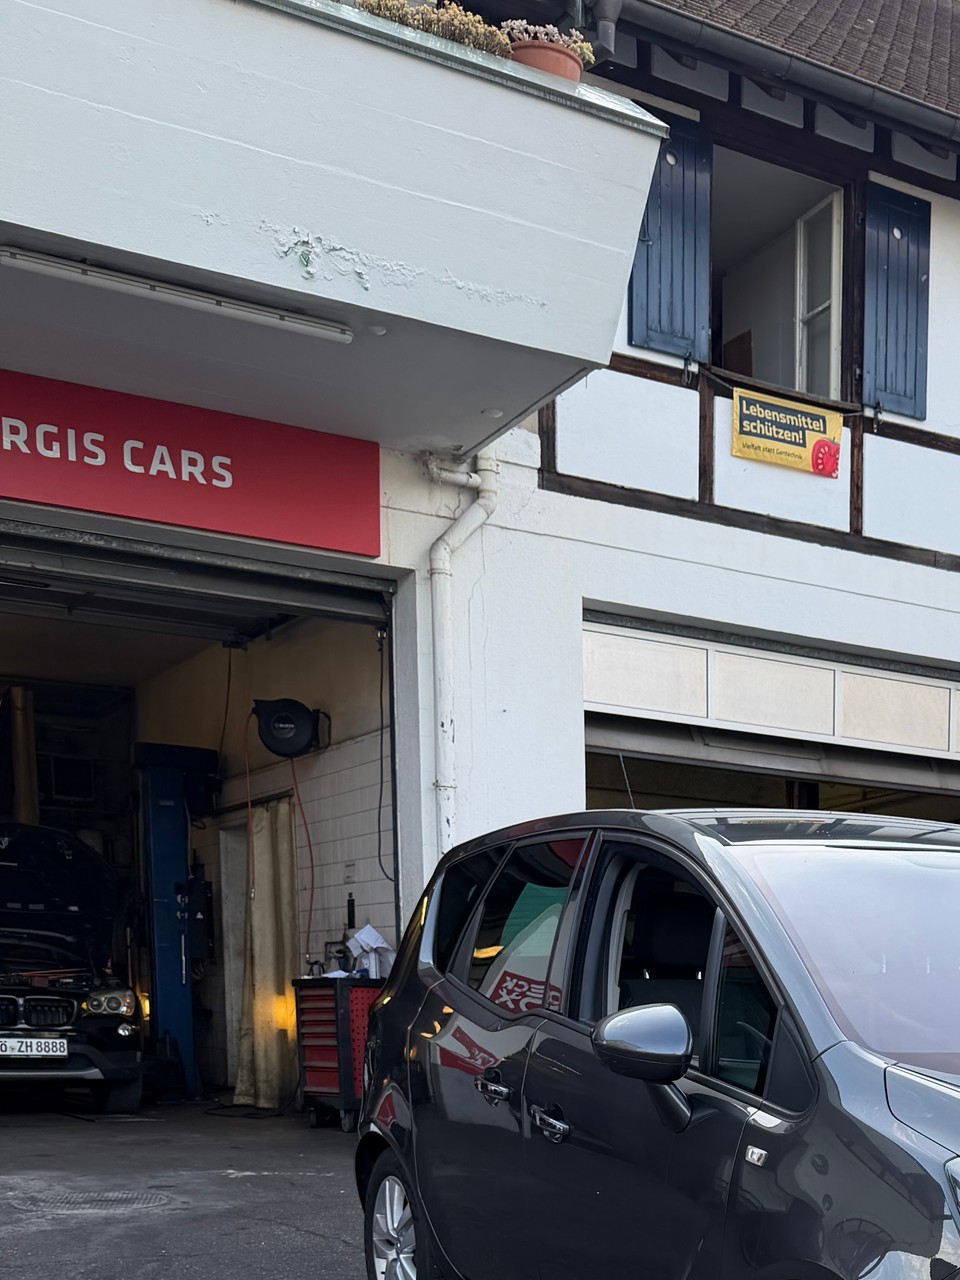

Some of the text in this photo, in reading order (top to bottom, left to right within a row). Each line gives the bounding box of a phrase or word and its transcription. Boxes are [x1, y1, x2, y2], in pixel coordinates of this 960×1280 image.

[742, 400, 824, 432] Lebensmittel
[742, 420, 803, 444] schützen!
[742, 442, 762, 452] Vielfalt
[762, 446, 775, 454] statt
[122, 440, 234, 489] CARS
[17, 1040, 33, 1053] ZH
[36, 1041, 66, 1053] 8888
